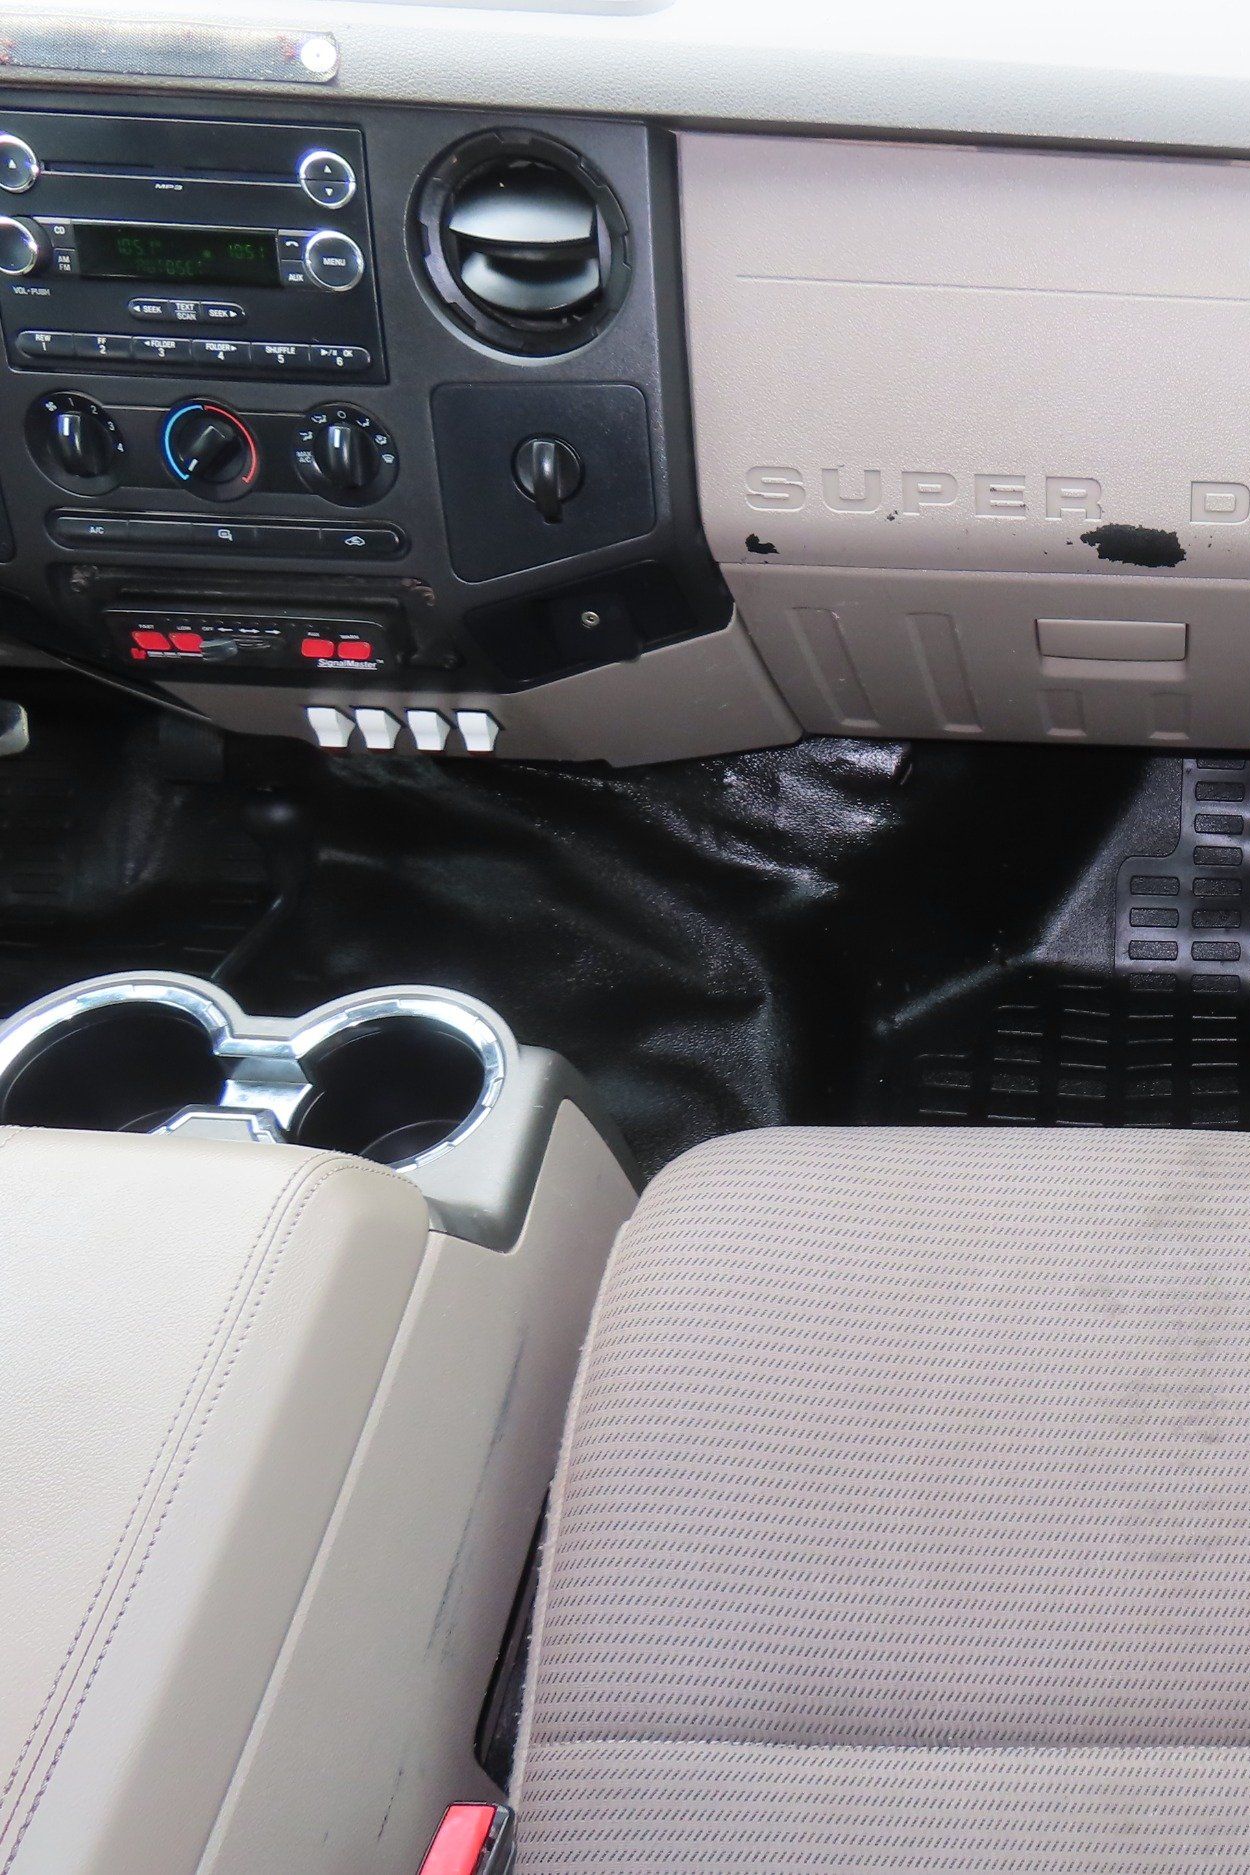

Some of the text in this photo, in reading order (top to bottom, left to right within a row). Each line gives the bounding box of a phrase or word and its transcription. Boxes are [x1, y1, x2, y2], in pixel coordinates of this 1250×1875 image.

[155, 183, 183, 191] MP3
[53, 226, 66, 235] CD
[57, 255, 71, 263] AM
[322, 257, 346, 267] MENU
[59, 264, 71, 272] FM
[288, 273, 304, 282] AUX
[142, 305, 162, 314] SEEK
[176, 302, 195, 311] TEXT
[176, 312, 197, 320] SCAN
[208, 309, 229, 318] SEEK
[35, 333, 52, 342] REW
[97, 337, 107, 345] FF
[42, 342, 47, 351] 1
[99, 345, 107, 354] 2
[151, 341, 176, 349] FOLDER
[205, 343, 231, 351] FOLDER
[158, 348, 166, 358] 3
[265, 346, 296, 355] SHUFFLE
[217, 351, 225, 360] 4
[276, 354, 285, 364] 5
[336, 357, 344, 367] 6
[90, 405, 99, 415] 2
[107, 421, 116, 431] 3
[117, 443, 125, 453] 4
[745, 466, 1103, 522] SUPER
[89, 525, 105, 535] A/C
